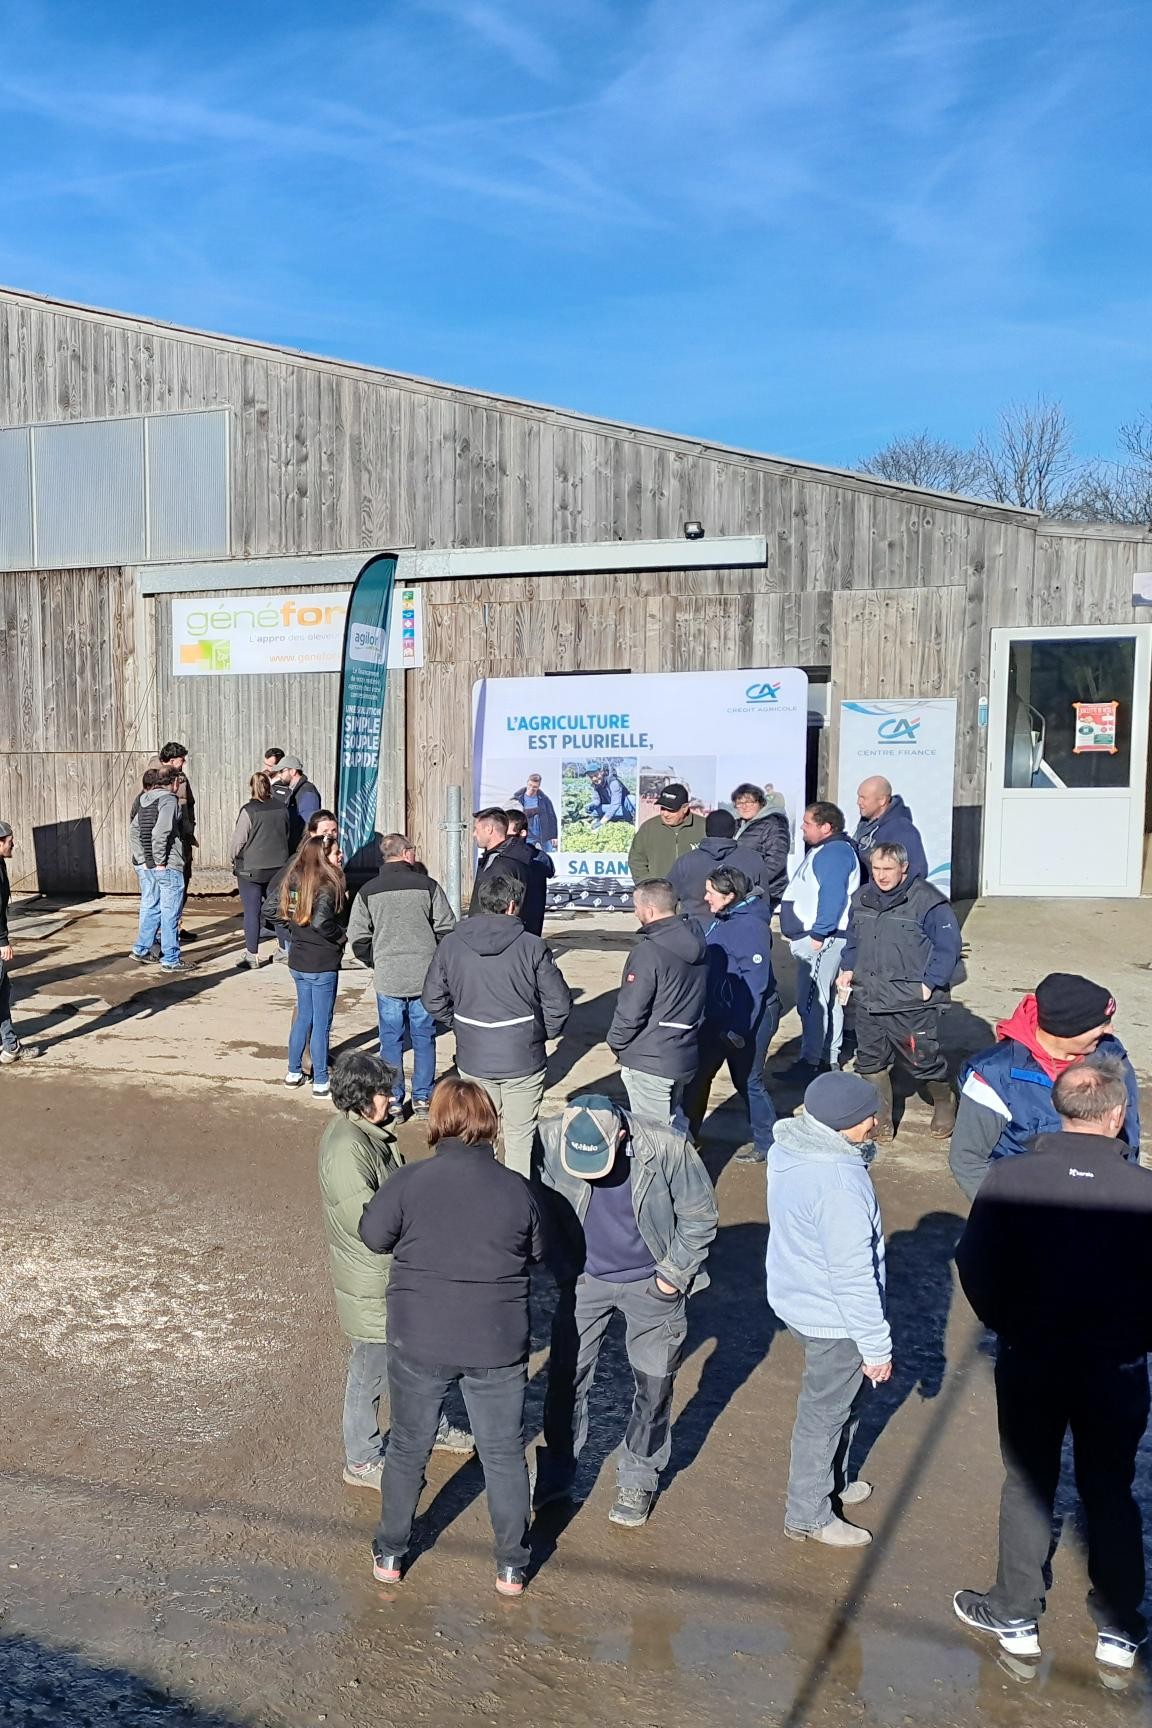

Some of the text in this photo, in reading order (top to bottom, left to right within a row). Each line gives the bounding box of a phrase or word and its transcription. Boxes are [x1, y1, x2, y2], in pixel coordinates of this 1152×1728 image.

[186, 601, 347, 636] généfor
[354, 631, 379, 646] agilor
[344, 715, 381, 734] SIMPLE
[507, 713, 630, 731] L'AGRICULTURE
[343, 733, 380, 750] SOUPLE
[528, 732, 654, 751] EST PLURIELLE,
[342, 751, 378, 768] RAPIDE
[857, 748, 937, 757] CENTRE FRANCE
[568, 859, 630, 876] SA BAN
